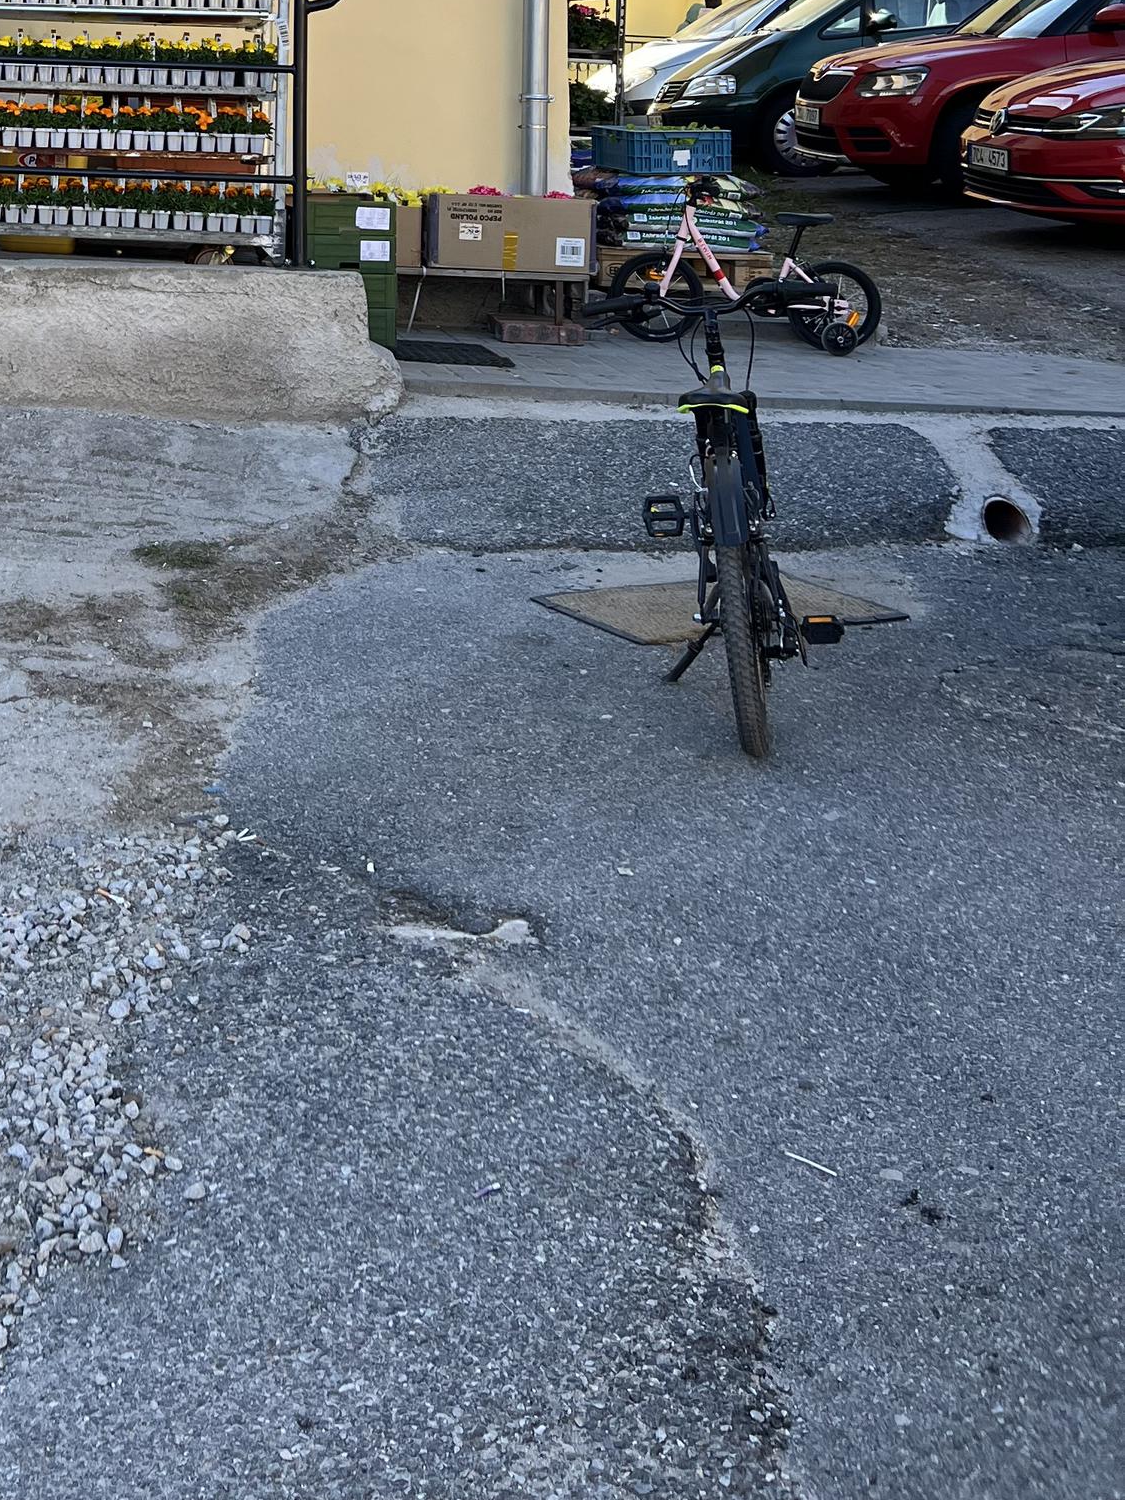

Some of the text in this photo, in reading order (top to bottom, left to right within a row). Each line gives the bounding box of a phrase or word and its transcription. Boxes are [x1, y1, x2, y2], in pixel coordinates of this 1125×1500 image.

[988, 150, 1006, 168] 4573
[450, 213, 503, 222] PEPCO POLAND
